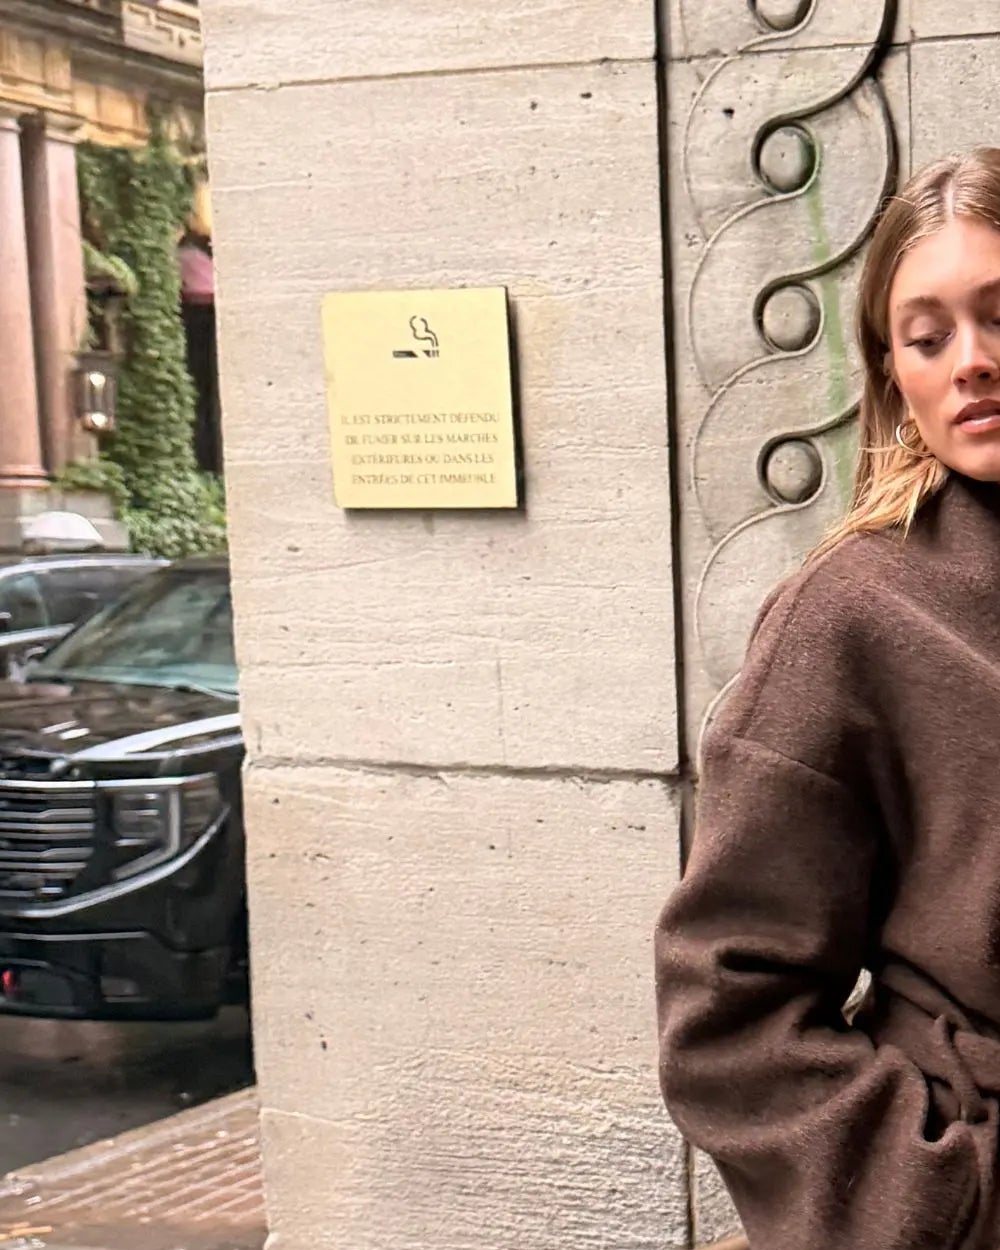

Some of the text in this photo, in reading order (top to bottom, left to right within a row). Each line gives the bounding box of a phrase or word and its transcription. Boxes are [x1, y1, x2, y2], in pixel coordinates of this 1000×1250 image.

[353, 414, 371, 425] EST
[374, 413, 447, 424] STRICTEMENT
[362, 434, 398, 445] FUMER
[400, 433, 421, 445] SUR
[424, 433, 444, 444] LES
[443, 453, 472, 464] DANS
[475, 453, 495, 464] LES
[400, 473, 413, 484] DE
[416, 473, 436, 484] CET
